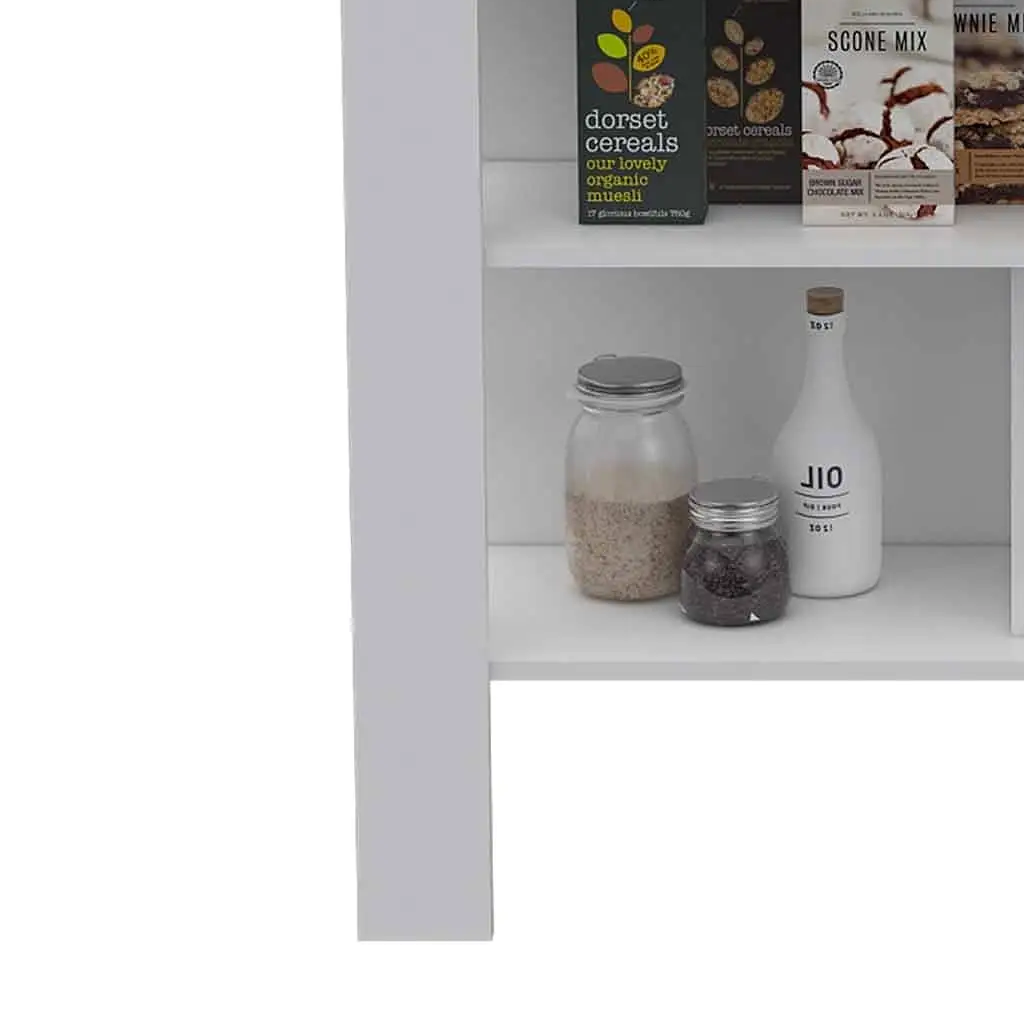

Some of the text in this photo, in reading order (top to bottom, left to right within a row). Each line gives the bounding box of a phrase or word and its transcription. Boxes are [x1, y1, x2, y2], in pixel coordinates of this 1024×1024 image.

[828, 30, 928, 52] SCONE MIX
[585, 109, 668, 129] dorset
[743, 123, 793, 137] cereals
[585, 132, 679, 153] cereals
[586, 157, 668, 173] our lovely
[586, 172, 649, 189] organic
[586, 189, 643, 202] muesli
